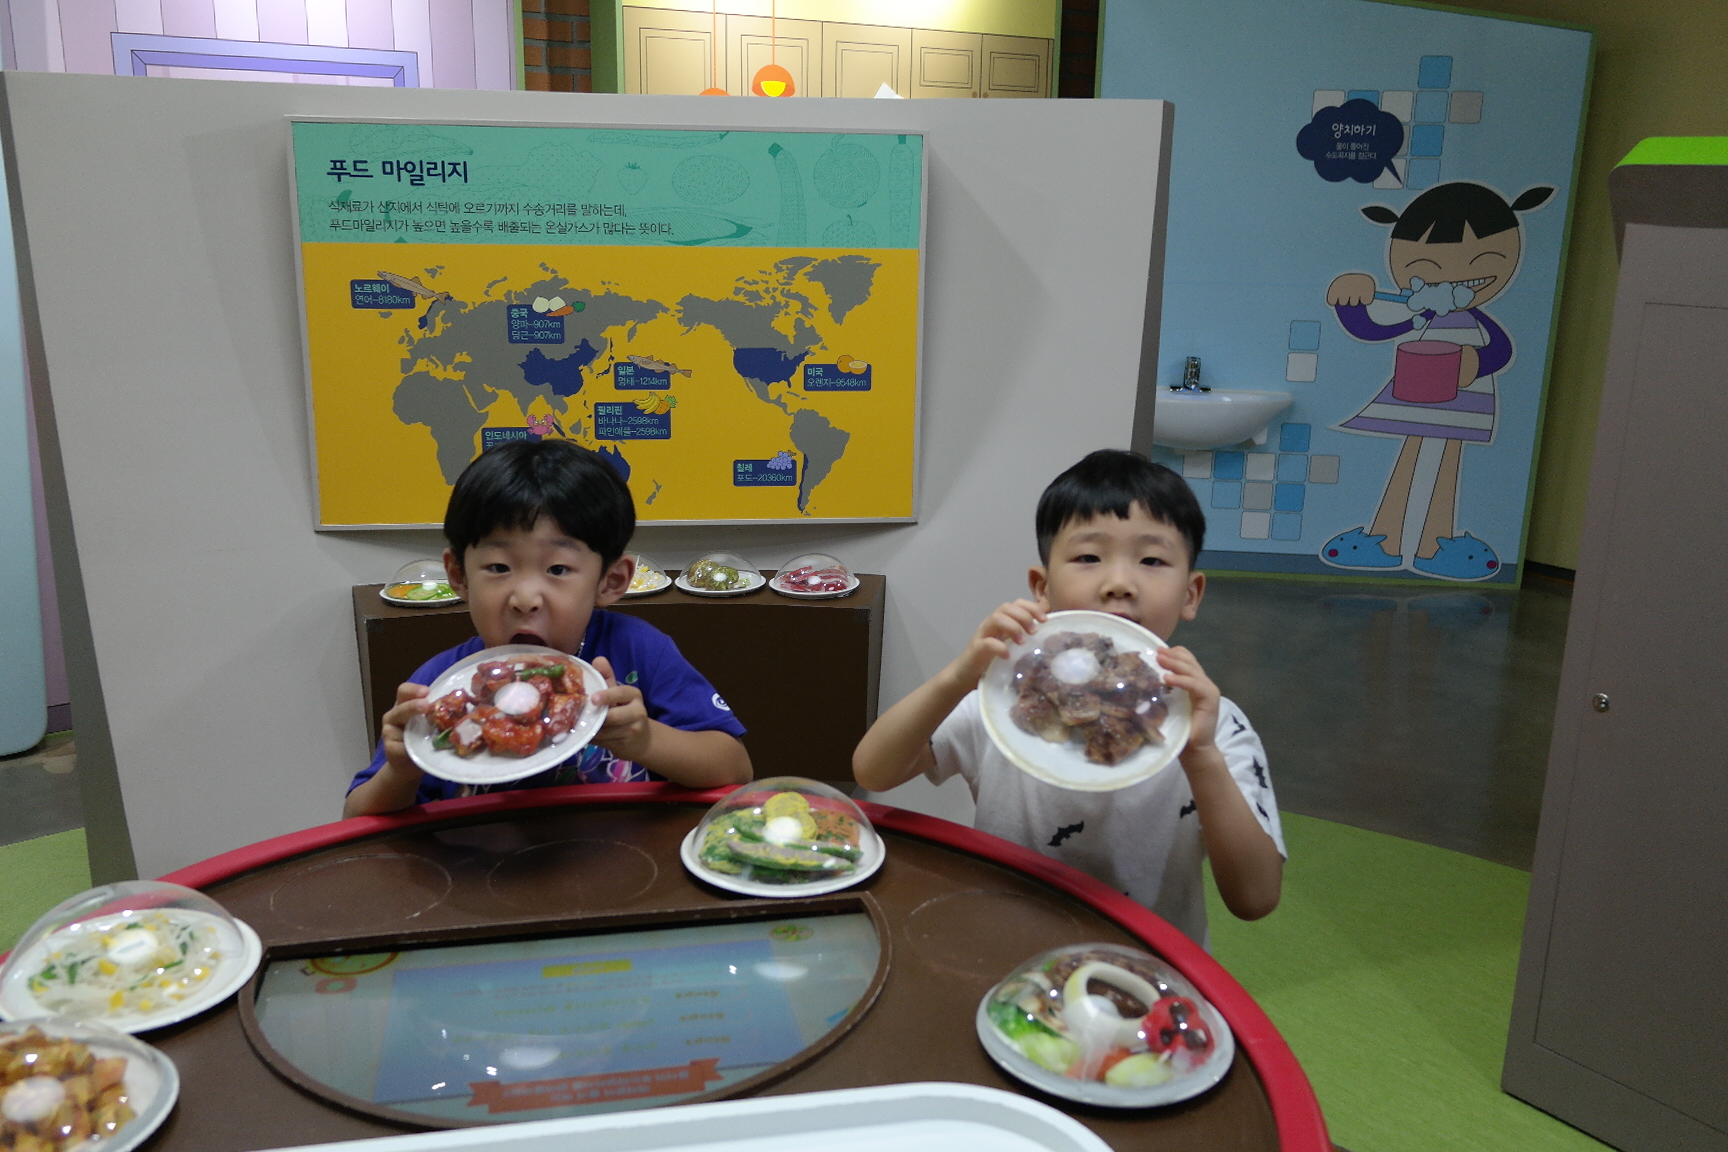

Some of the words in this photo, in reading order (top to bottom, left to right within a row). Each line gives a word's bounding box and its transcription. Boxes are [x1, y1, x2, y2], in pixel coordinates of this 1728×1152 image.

[326, 159, 374, 182] 푸드
[382, 159, 469, 186] 마일리지
[328, 200, 375, 214] 식재료가
[377, 201, 423, 214] 산지에서
[426, 201, 460, 215] 식탁에
[463, 201, 520, 215] 오르기까지
[522, 203, 578, 216] 수송거리를
[580, 203, 627, 217] 말하는데,
[329, 219, 410, 232] 푸드마일리지가
[412, 219, 446, 233] 높으면
[450, 220, 494, 233] 높을수록
[498, 220, 542, 234] 배출되는
[545, 221, 600, 235] 온실가스가
[603, 222, 637, 235] 많다는
[639, 222, 675, 236] 뜻이다.
[354, 283, 390, 293] 노르웨이
[510, 307, 528, 319] 중국
[617, 365, 635, 376] 일본
[807, 367, 824, 377] 미국
[597, 405, 623, 416] 필리핀
[484, 430, 528, 440] 인도네시아
[736, 463, 753, 472] 칠레
